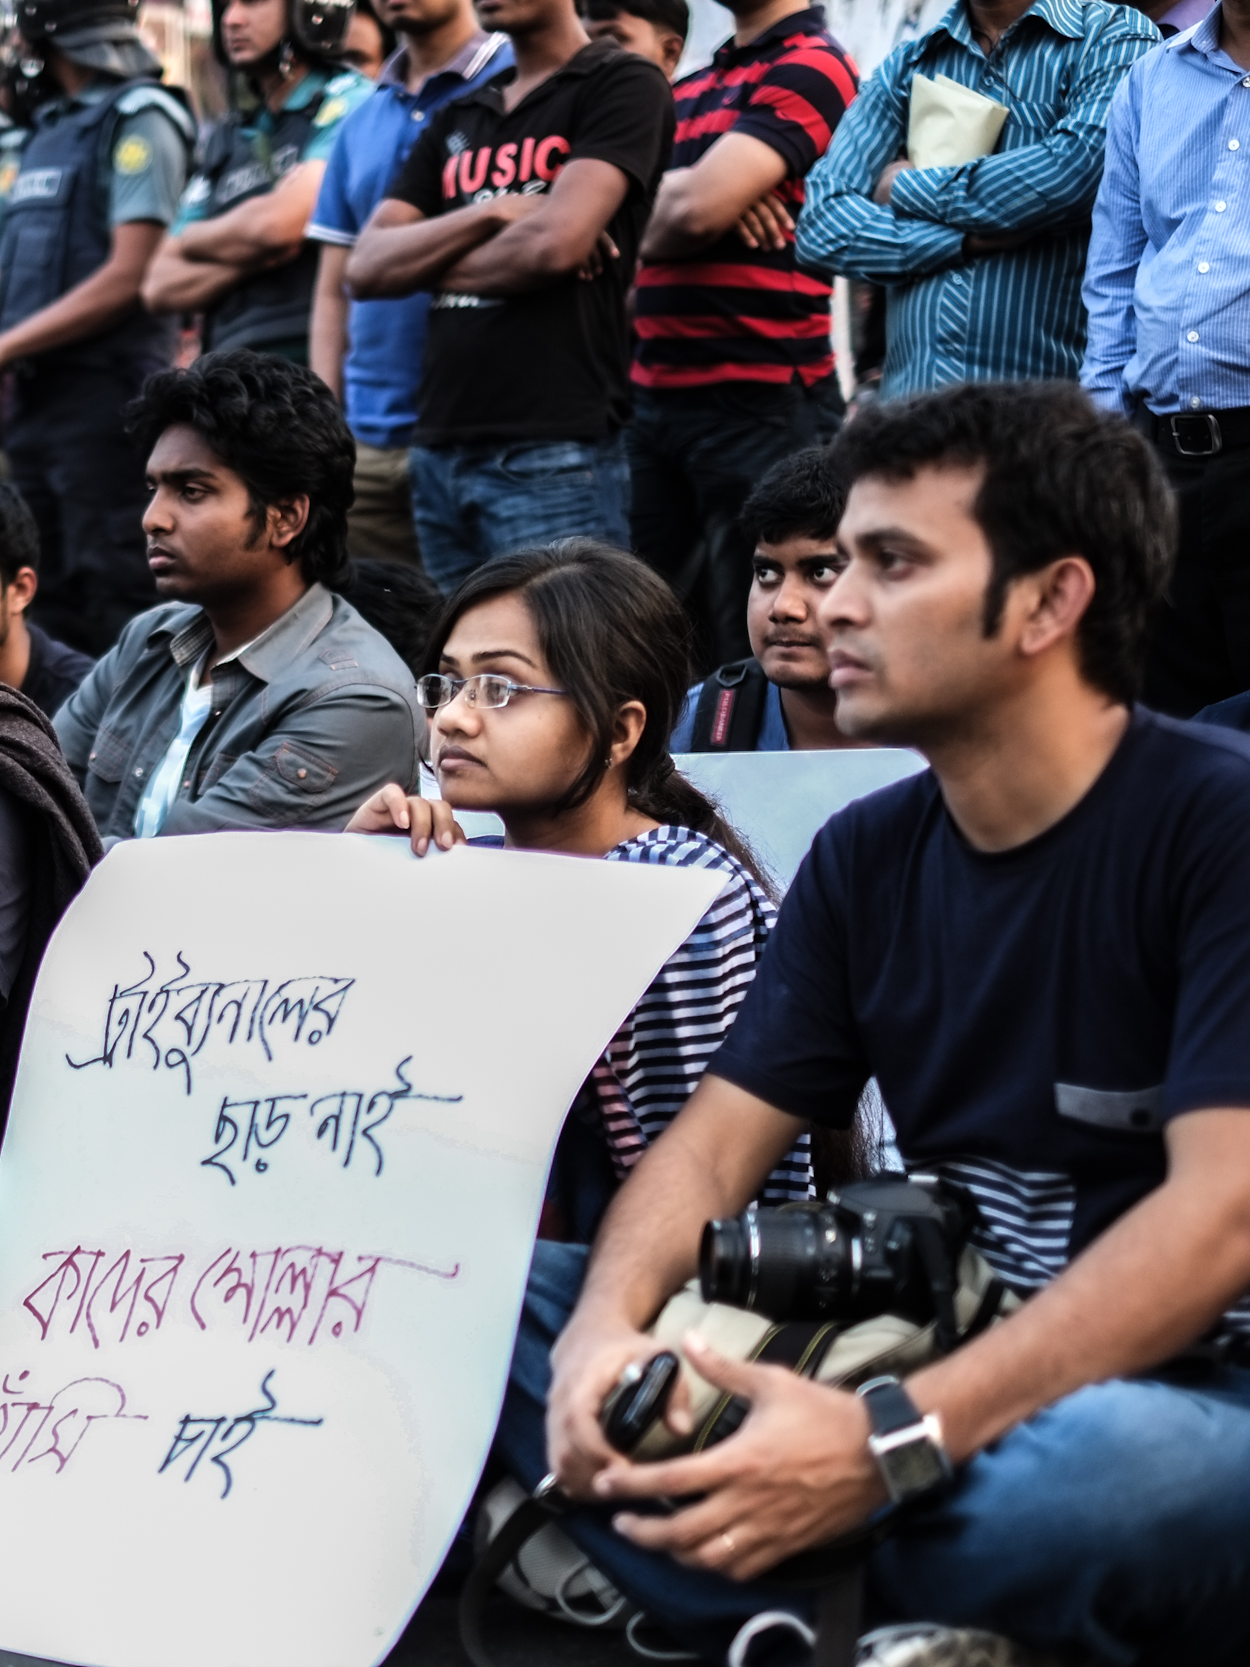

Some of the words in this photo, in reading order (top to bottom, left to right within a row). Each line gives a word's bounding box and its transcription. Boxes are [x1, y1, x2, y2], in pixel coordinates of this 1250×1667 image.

[311, 1056, 463, 1176] নাই
[23, 1245, 185, 1348] কাদের
[191, 1246, 460, 1345] মোল্লার
[158, 1369, 324, 1499] চাই
